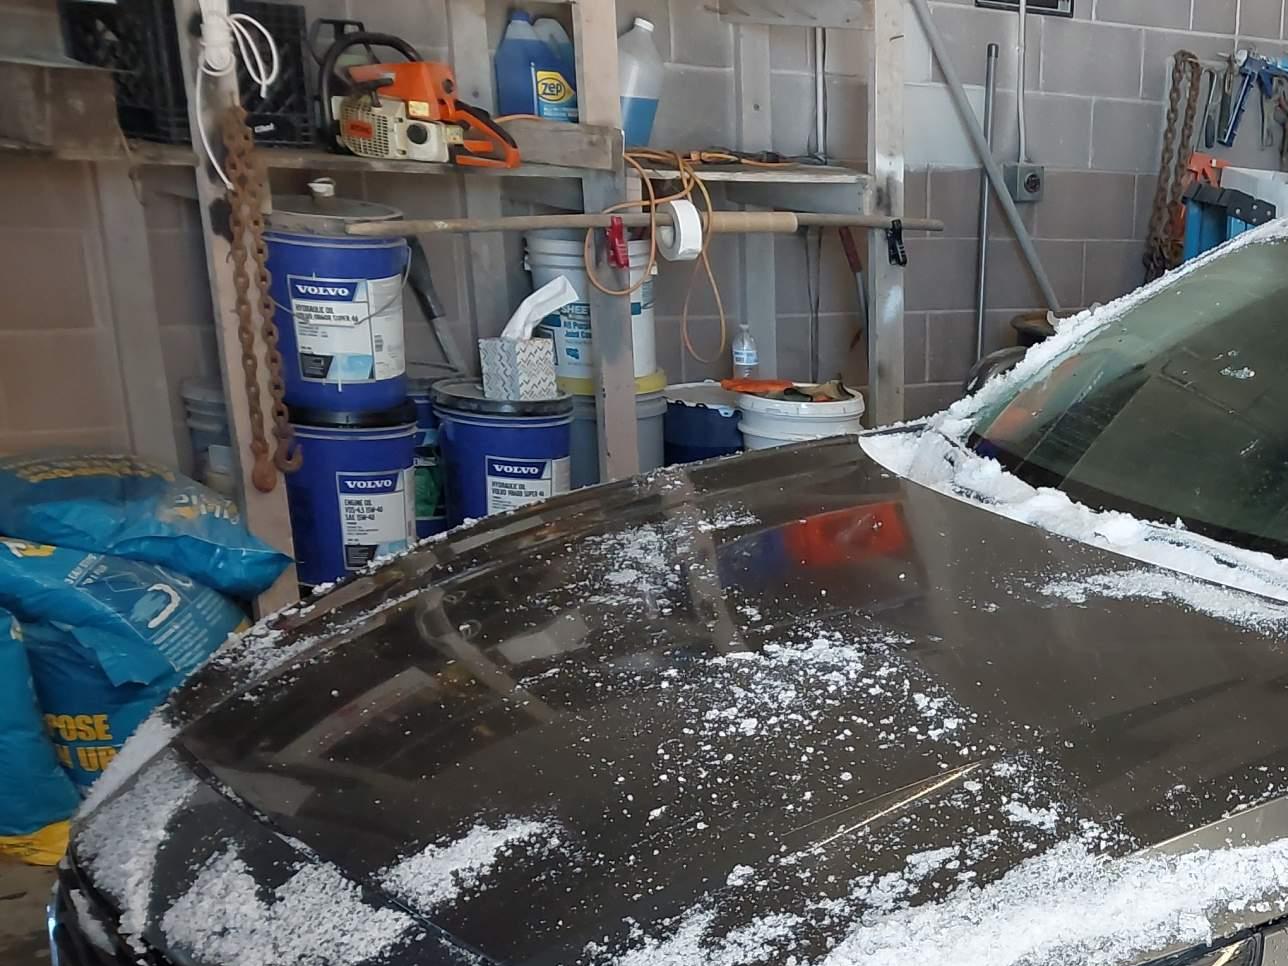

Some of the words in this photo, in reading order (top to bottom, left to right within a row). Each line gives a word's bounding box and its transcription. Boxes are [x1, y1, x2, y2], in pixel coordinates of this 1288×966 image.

[296, 285, 349, 295] VOLVO
[492, 464, 539, 474] VOLVO
[345, 480, 392, 488] VOLVO
